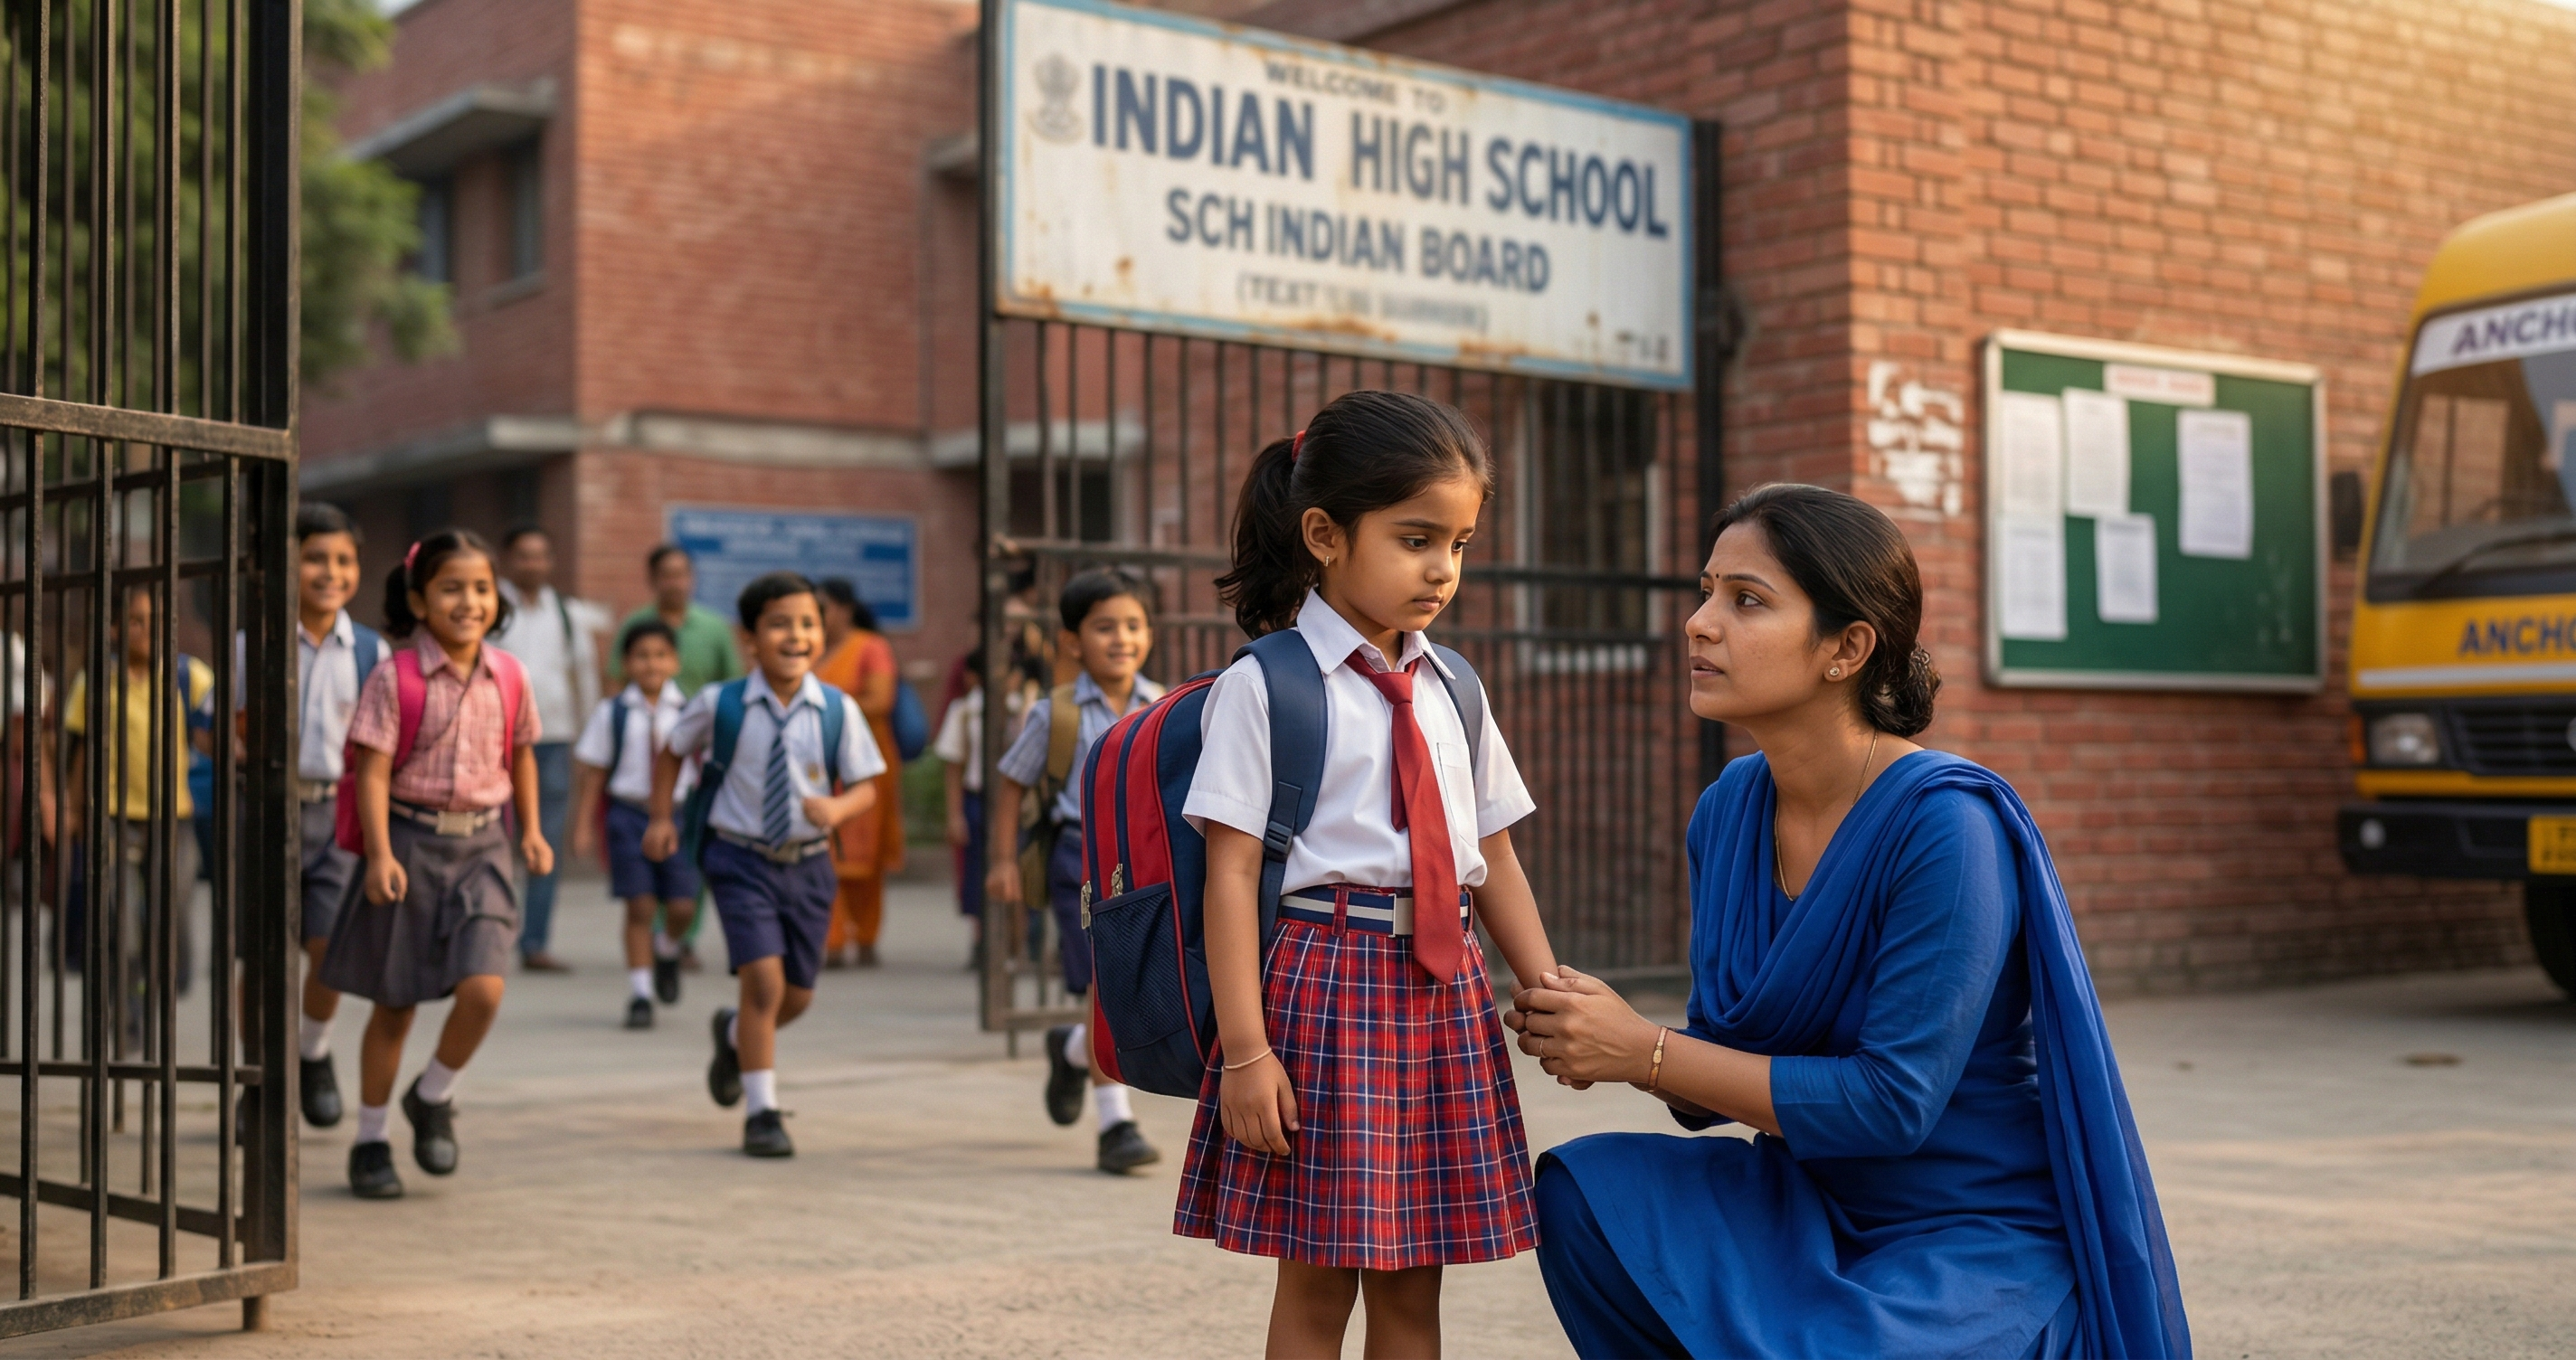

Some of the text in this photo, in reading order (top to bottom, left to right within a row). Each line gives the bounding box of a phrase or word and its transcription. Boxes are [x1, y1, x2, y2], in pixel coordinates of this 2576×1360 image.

[1266, 61, 1447, 114] WELCOME TO
[1092, 63, 1669, 239] INDIAN HIGH SCHOOL
[1166, 188, 1550, 293] SCH INDIAN BOARD
[2451, 305, 2576, 355] ANCH
